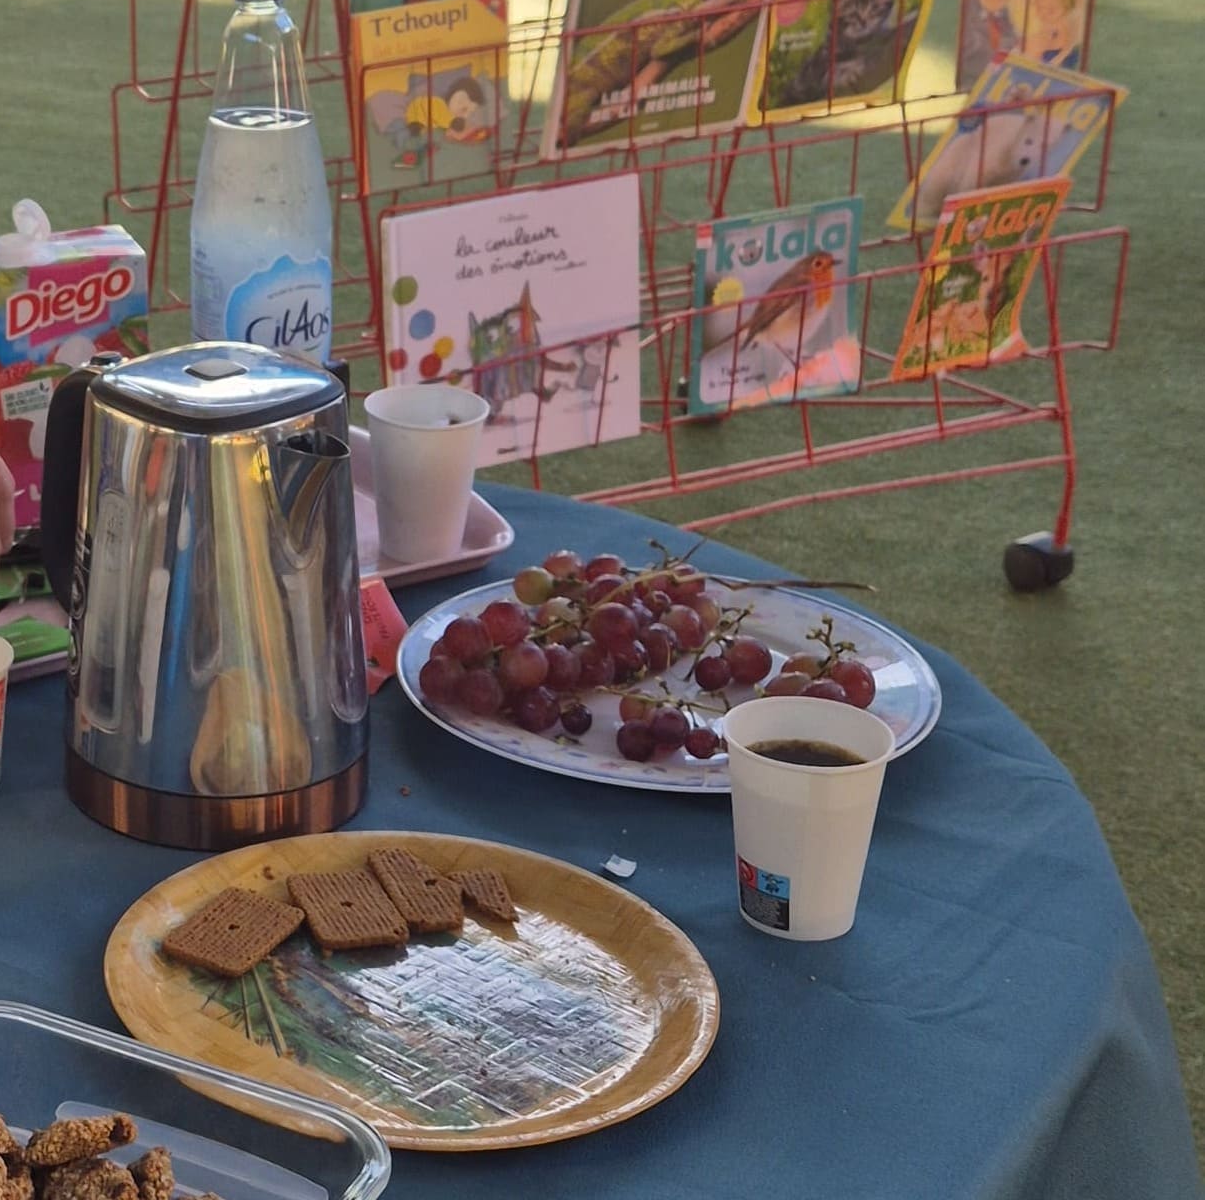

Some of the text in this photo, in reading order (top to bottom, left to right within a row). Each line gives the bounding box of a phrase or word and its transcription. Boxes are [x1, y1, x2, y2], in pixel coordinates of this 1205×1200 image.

[485, 225, 560, 253] couleur
[456, 263, 484, 280] des
[7, 266, 133, 338] Diego
